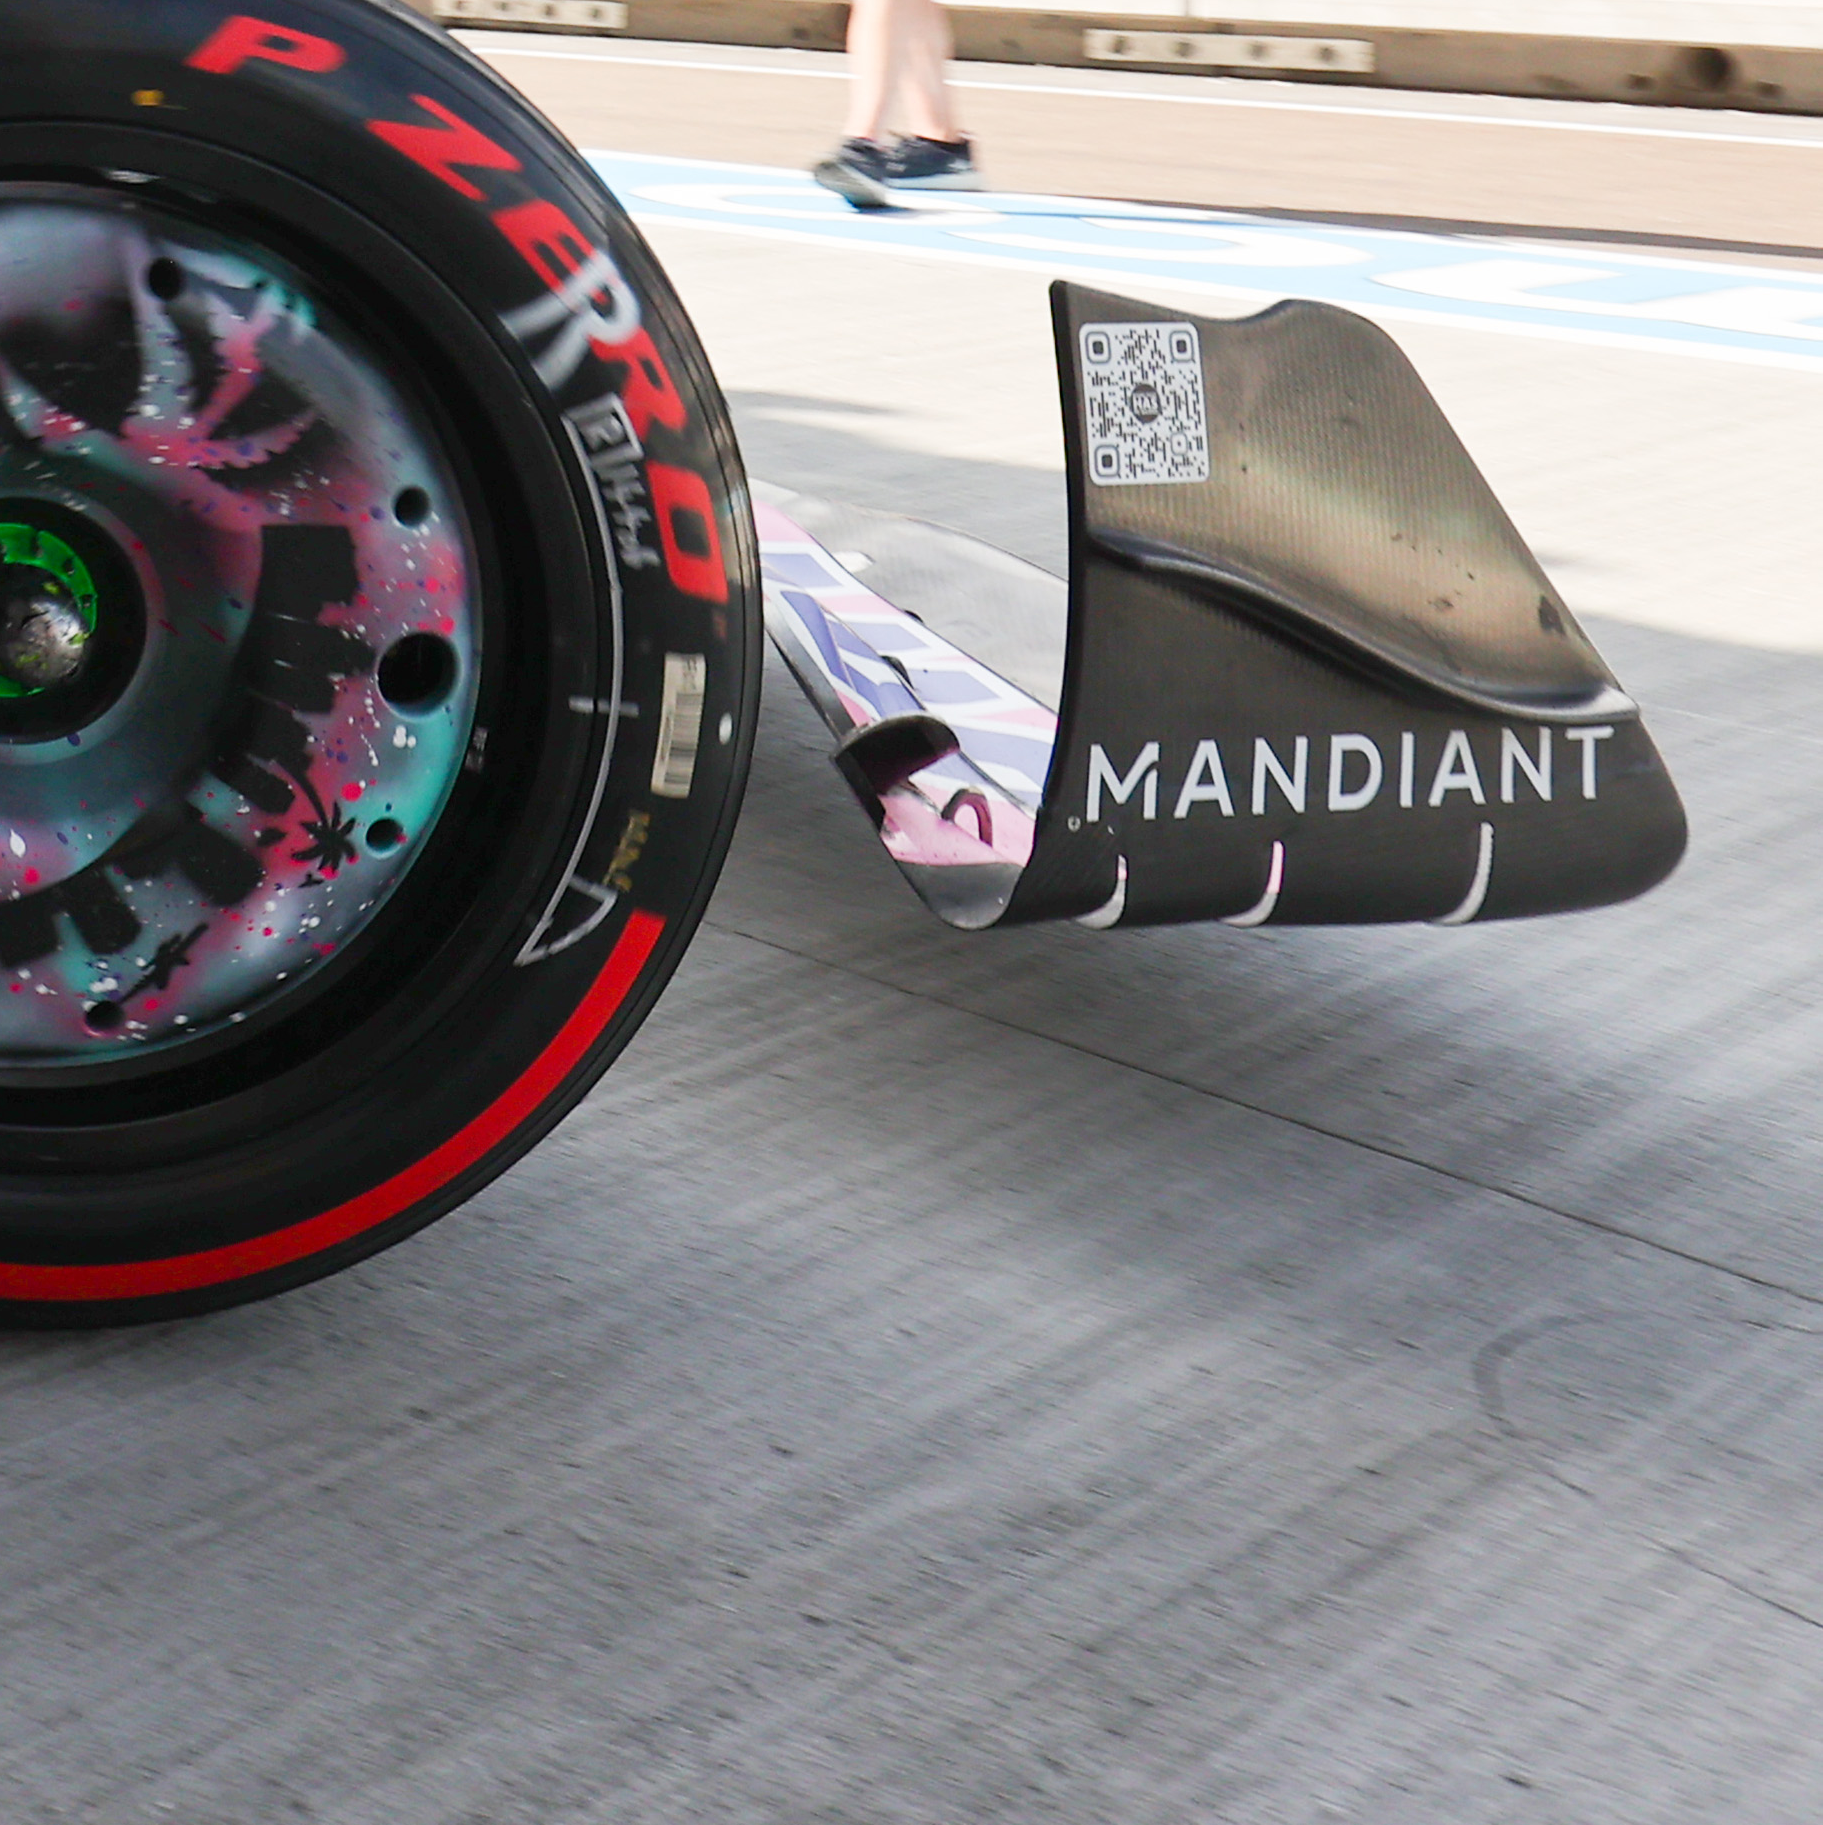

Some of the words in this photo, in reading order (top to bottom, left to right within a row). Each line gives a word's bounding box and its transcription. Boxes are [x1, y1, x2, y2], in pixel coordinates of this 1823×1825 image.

[184, 14, 348, 76] P
[366, 93, 730, 605] ZERO
[1085, 725, 1615, 825] MANDIANT
